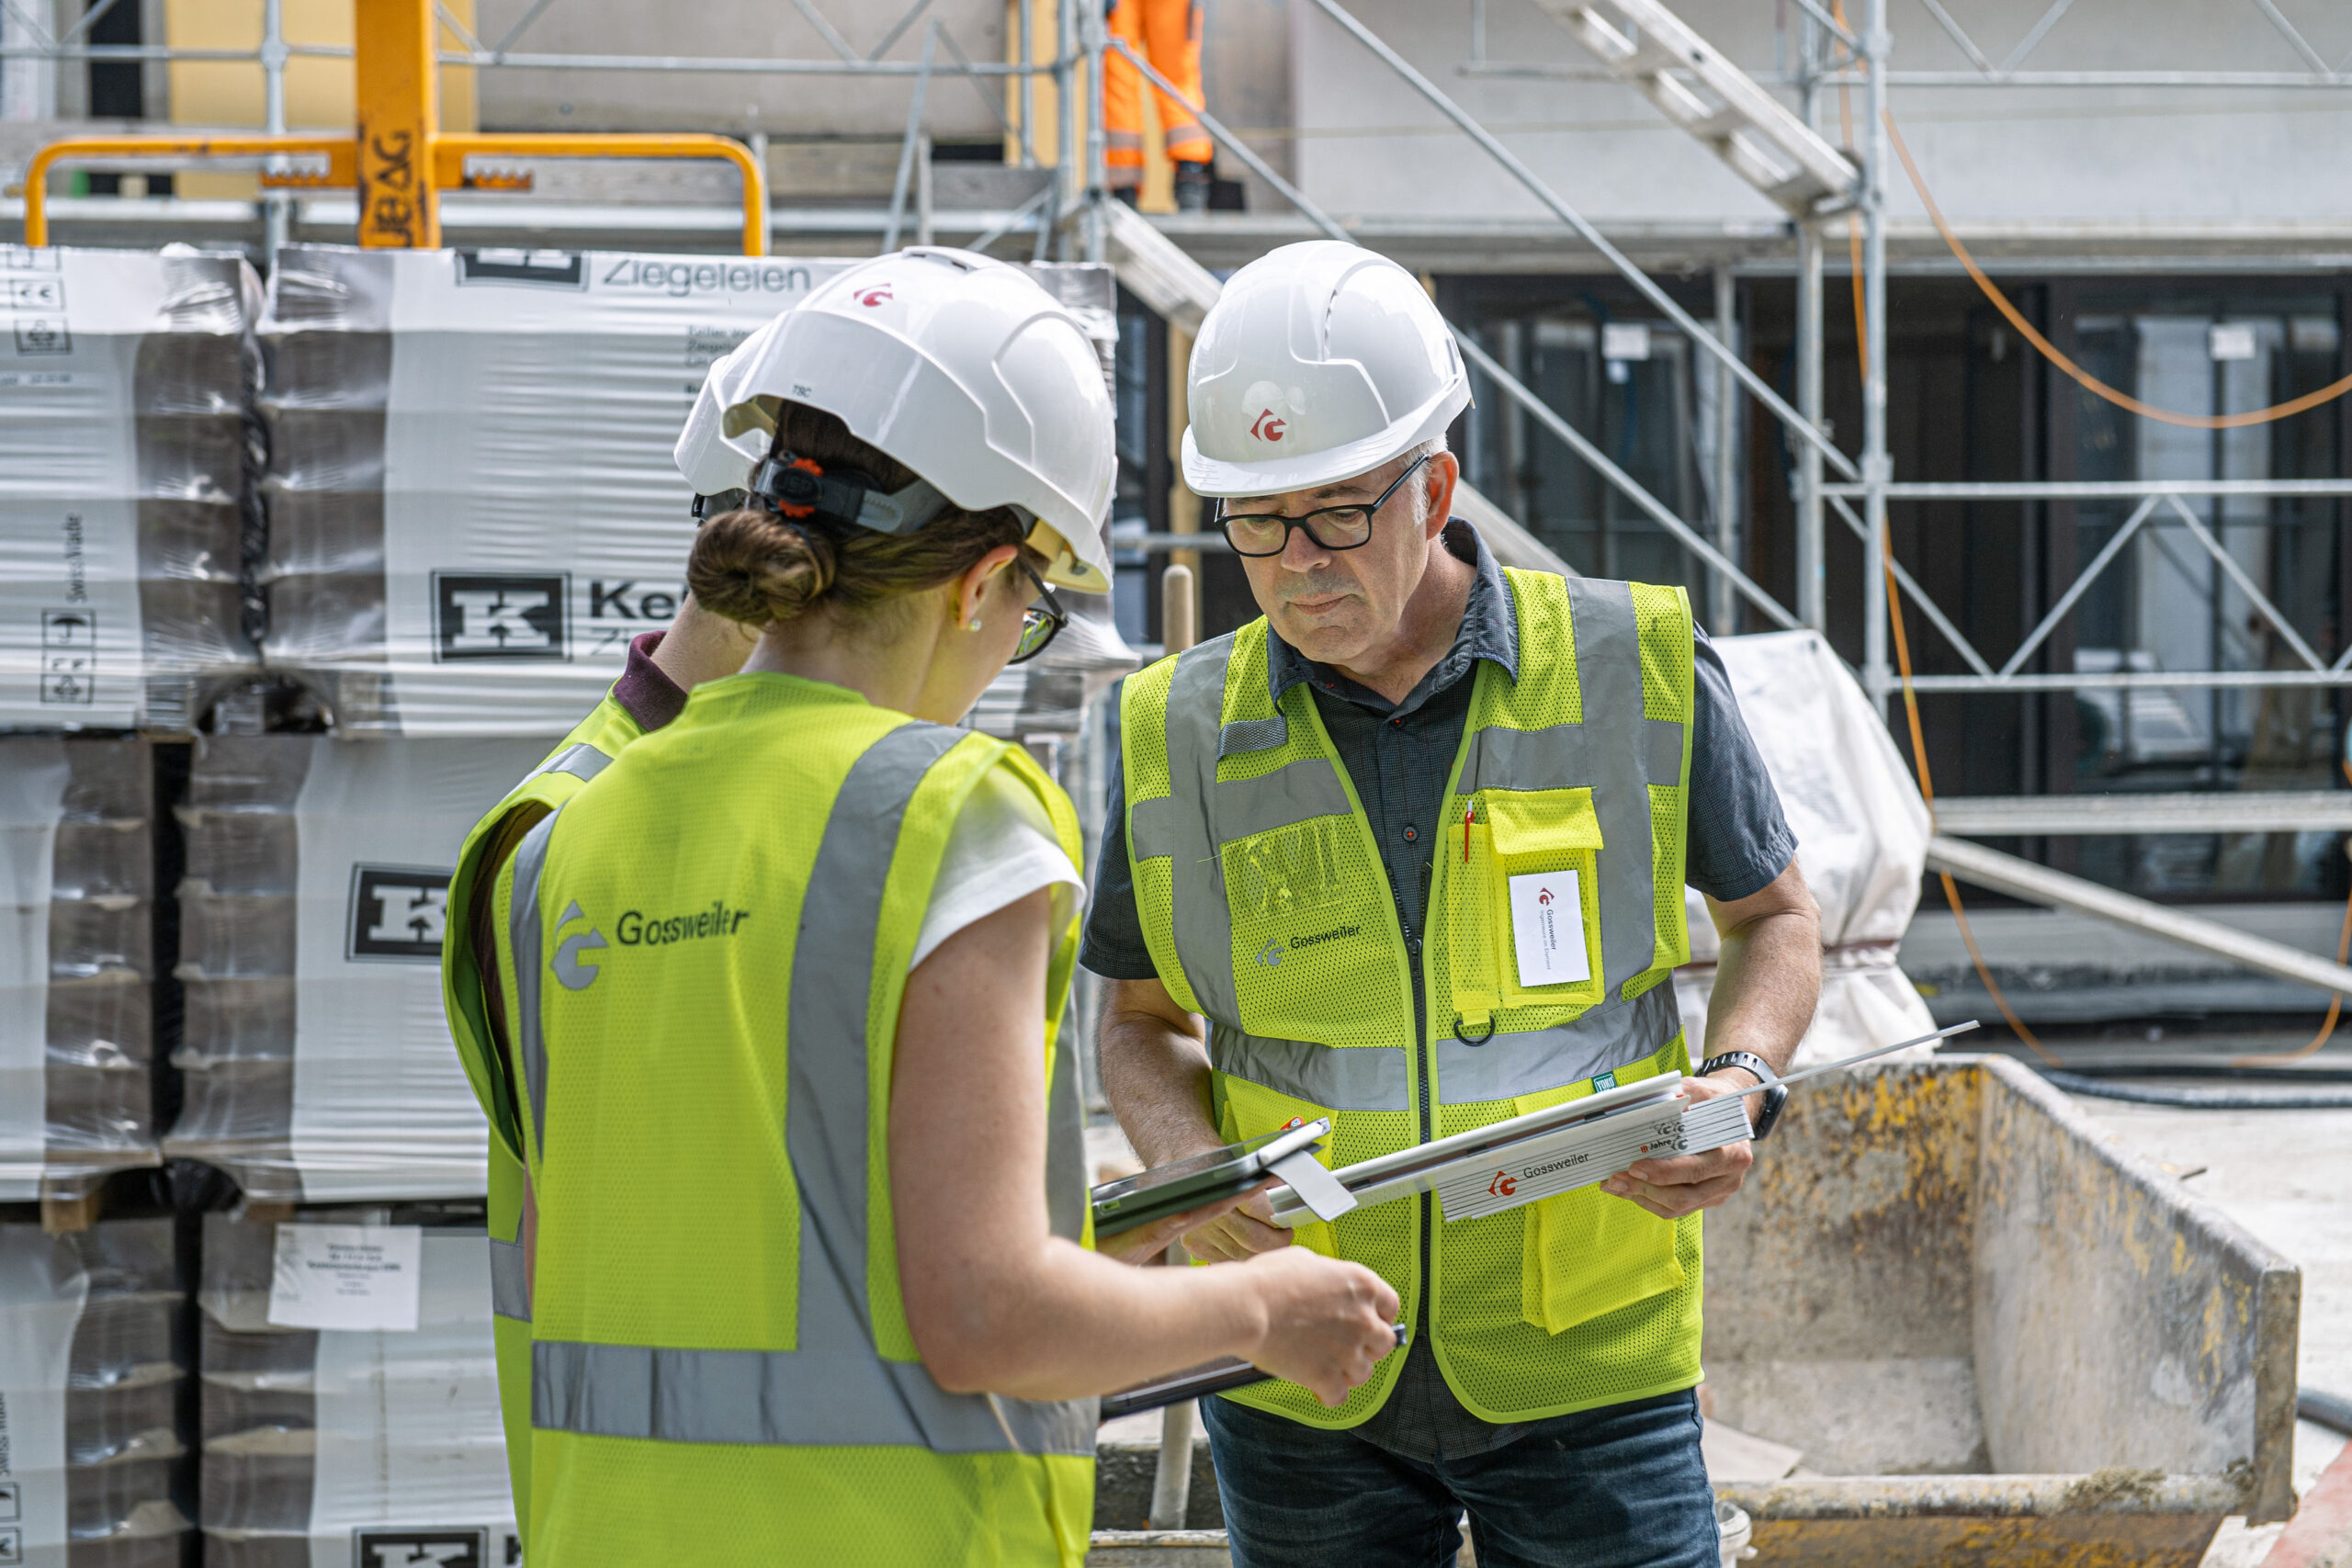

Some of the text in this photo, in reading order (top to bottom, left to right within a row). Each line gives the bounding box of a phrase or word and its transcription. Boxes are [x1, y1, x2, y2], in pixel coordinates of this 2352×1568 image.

[603, 258, 811, 298] Ziegeleien
[616, 900, 750, 947] Gossweiler
[1546, 908, 1557, 950] Gossweiler
[1290, 926, 1361, 950] Gossweiler
[1596, 1077, 1615, 1091] YOKO
[1649, 1139, 1672, 1150] Jahre
[1522, 1151, 1589, 1179] Gossweiler
